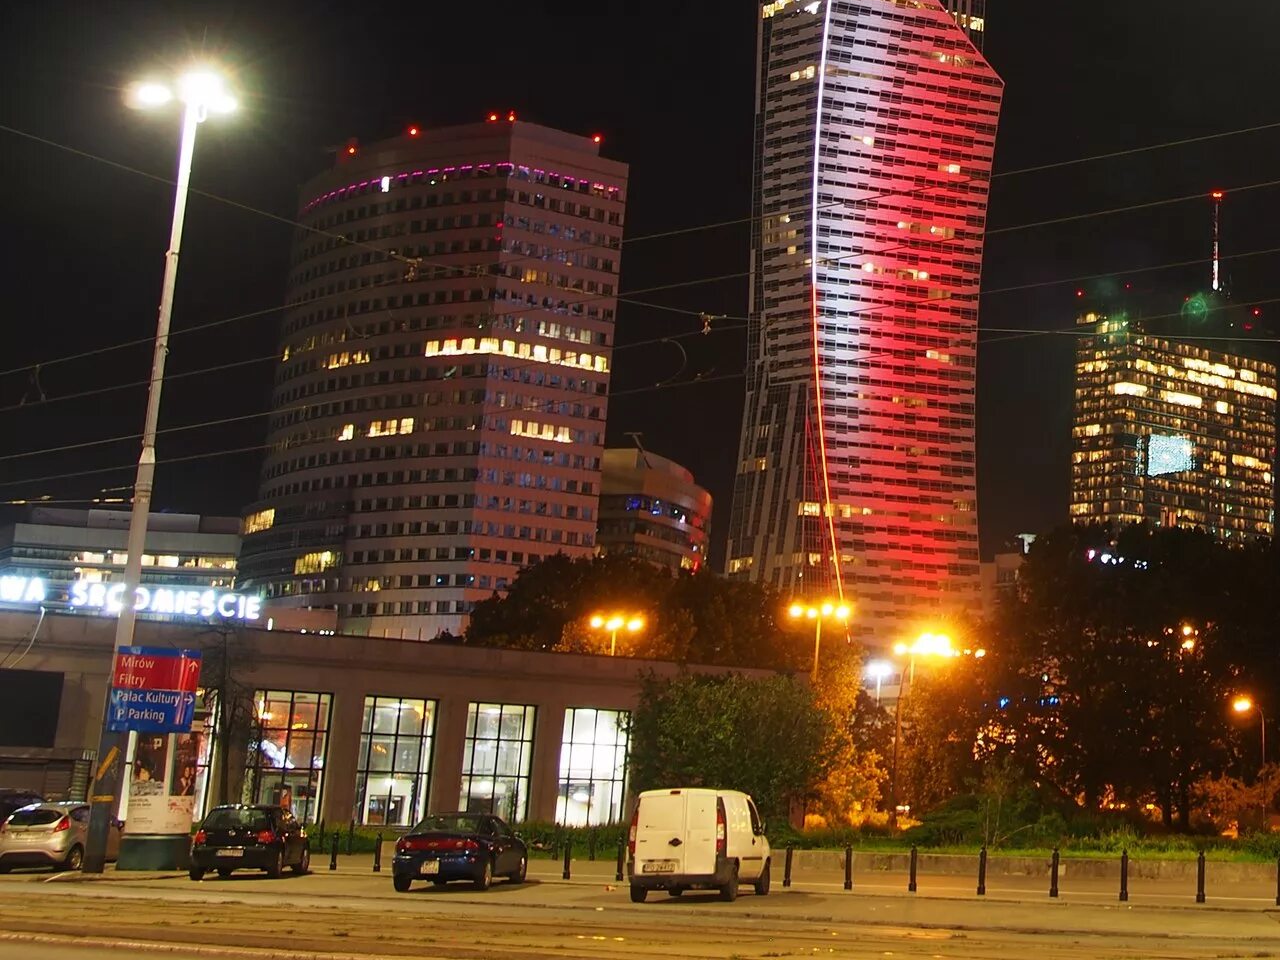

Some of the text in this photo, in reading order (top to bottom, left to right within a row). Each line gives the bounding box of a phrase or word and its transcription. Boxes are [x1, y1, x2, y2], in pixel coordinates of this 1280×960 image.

[121, 656, 155, 669] Mirów
[119, 673, 146, 688] Filtry
[145, 692, 180, 707] Kultury
[128, 709, 165, 724] Parking
